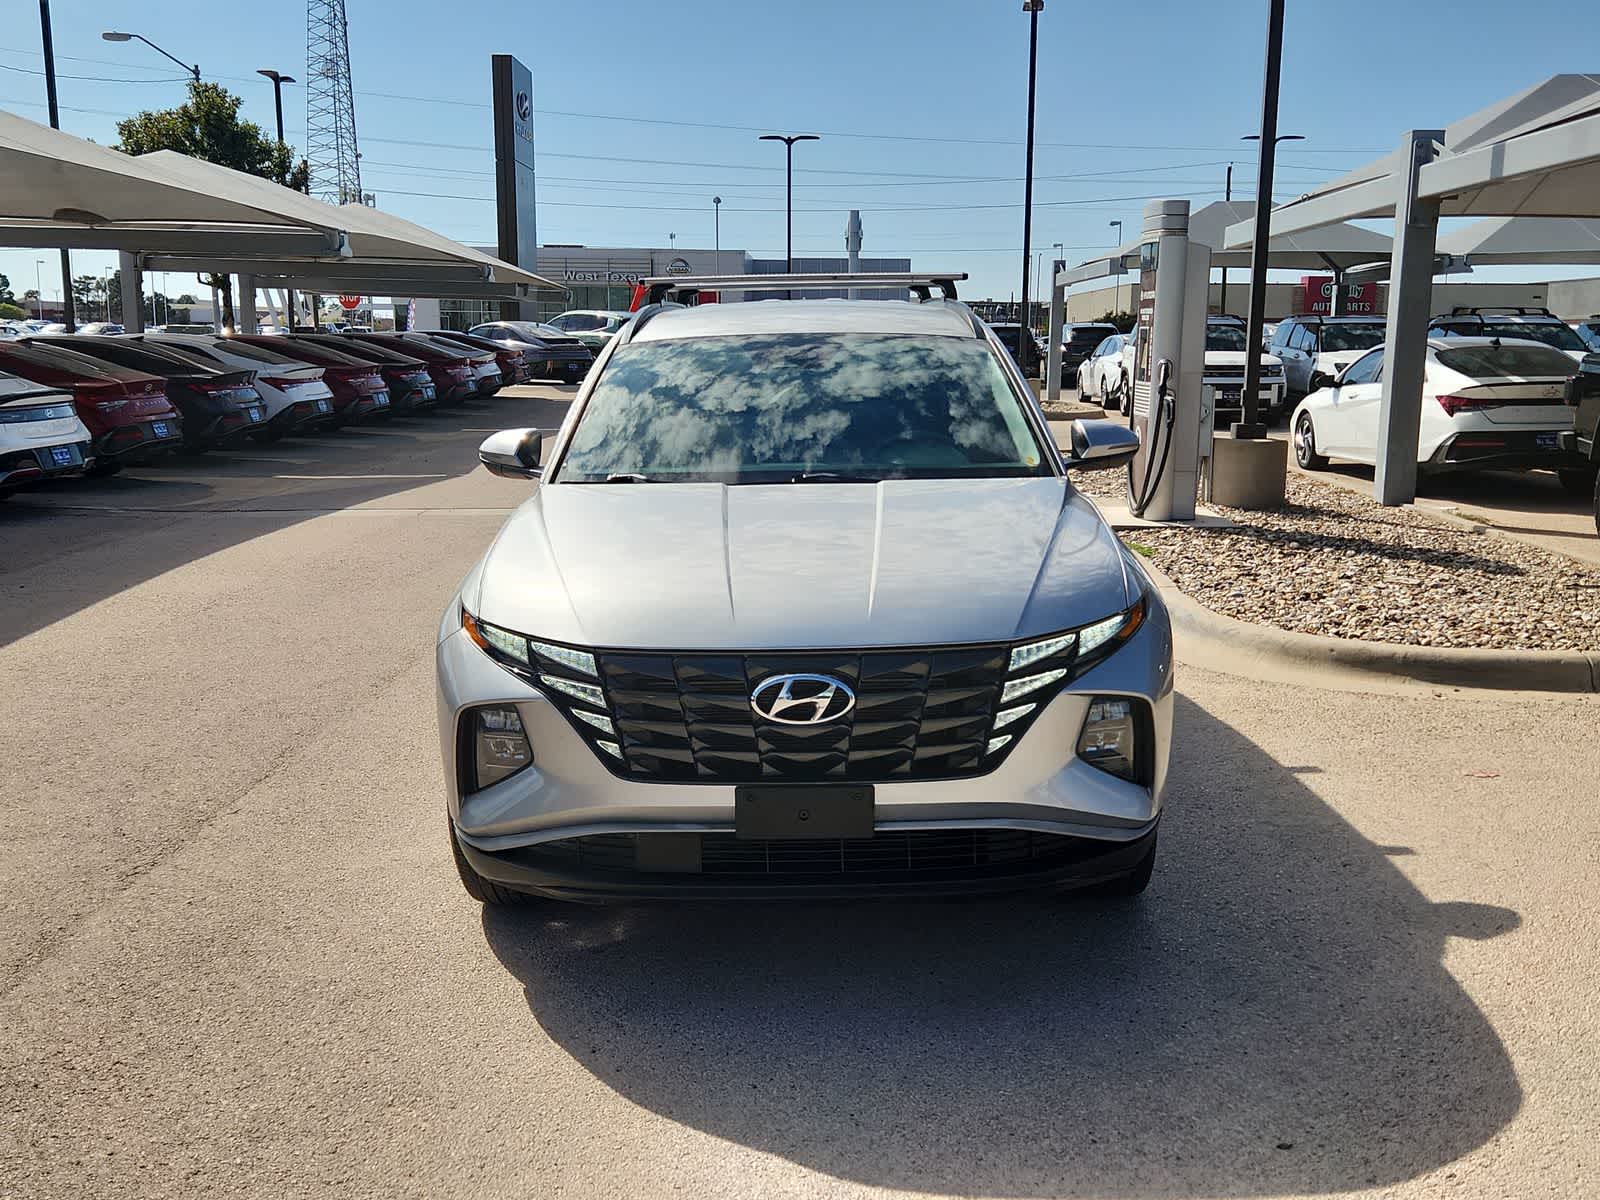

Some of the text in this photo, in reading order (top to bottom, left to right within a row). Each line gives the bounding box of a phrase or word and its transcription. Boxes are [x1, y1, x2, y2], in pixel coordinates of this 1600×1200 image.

[563, 271, 598, 281] West
[1312, 302, 1371, 312] AUT ARTS
